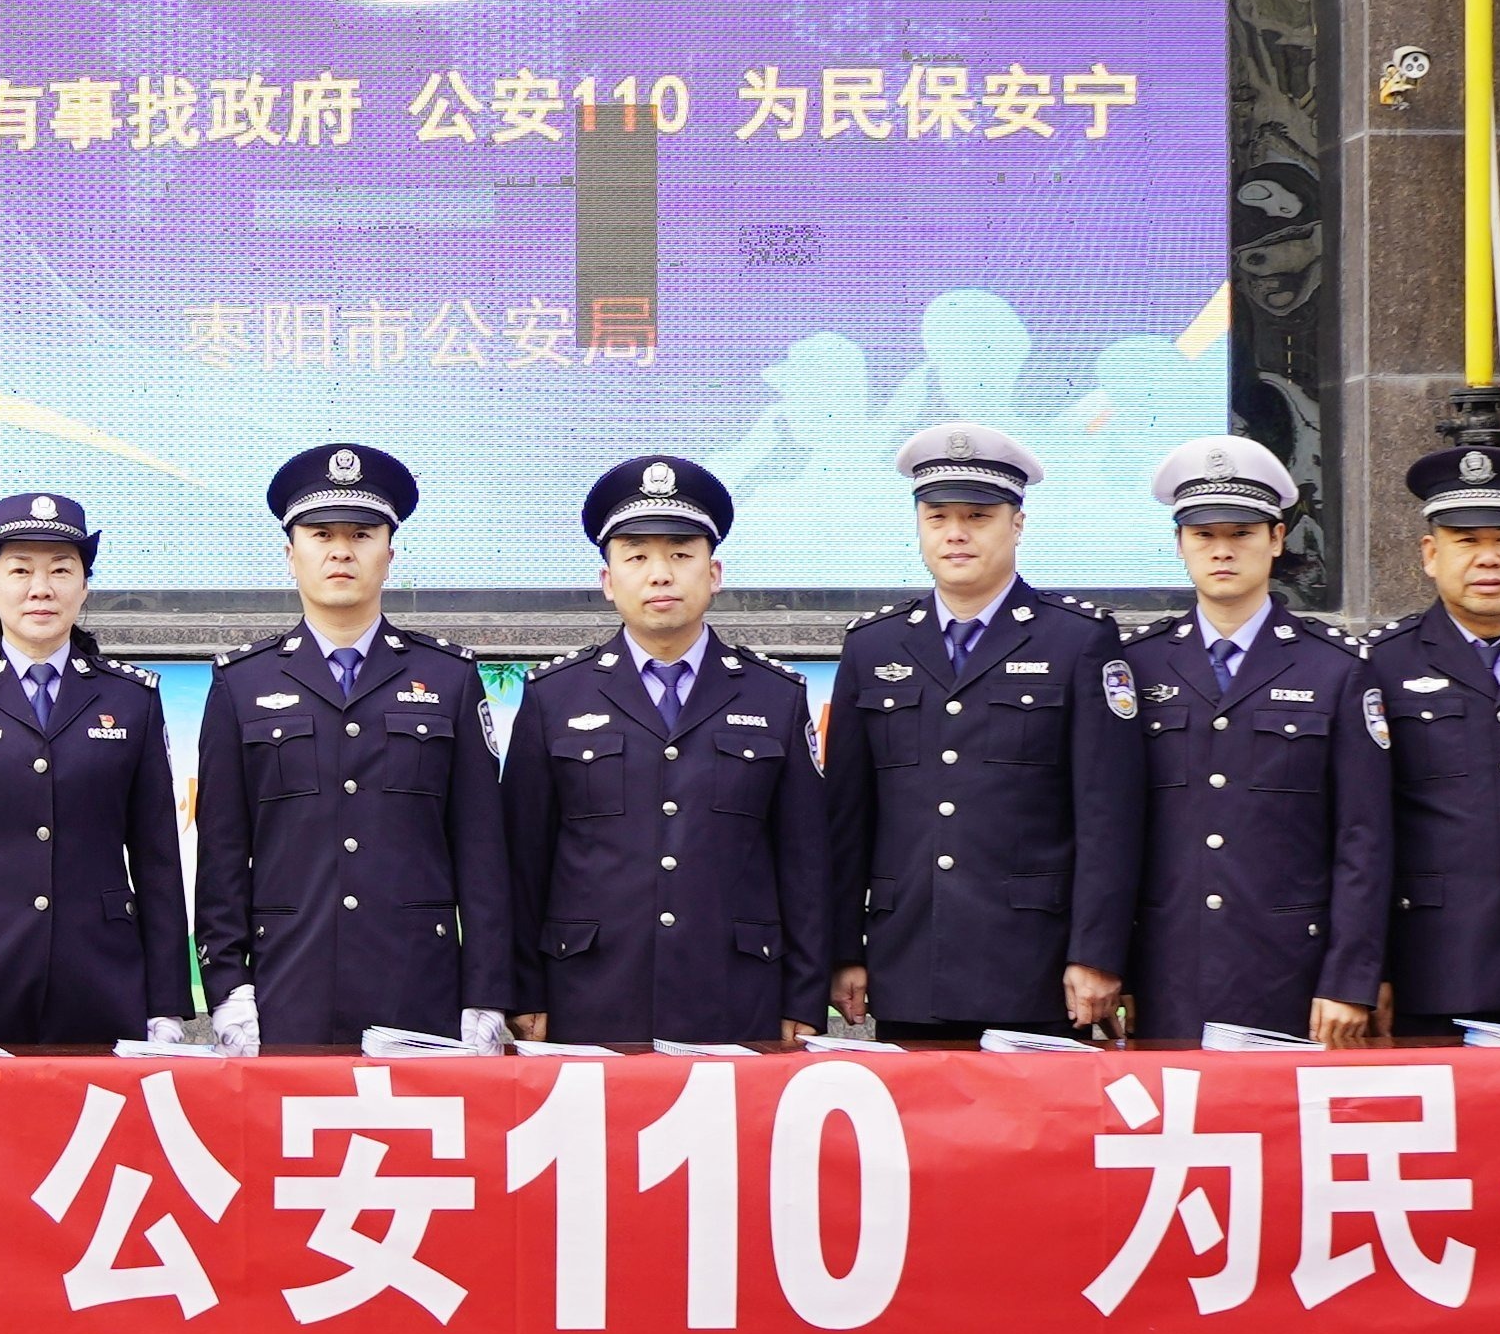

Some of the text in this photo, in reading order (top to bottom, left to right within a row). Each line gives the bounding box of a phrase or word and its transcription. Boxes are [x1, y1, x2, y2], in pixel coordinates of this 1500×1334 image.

[407, 68, 690, 147] 公安110
[735, 63, 1138, 142] 为民保安宁
[182, 295, 658, 371] 枣阳市公安局
[30, 1059, 911, 1331] 公安110
